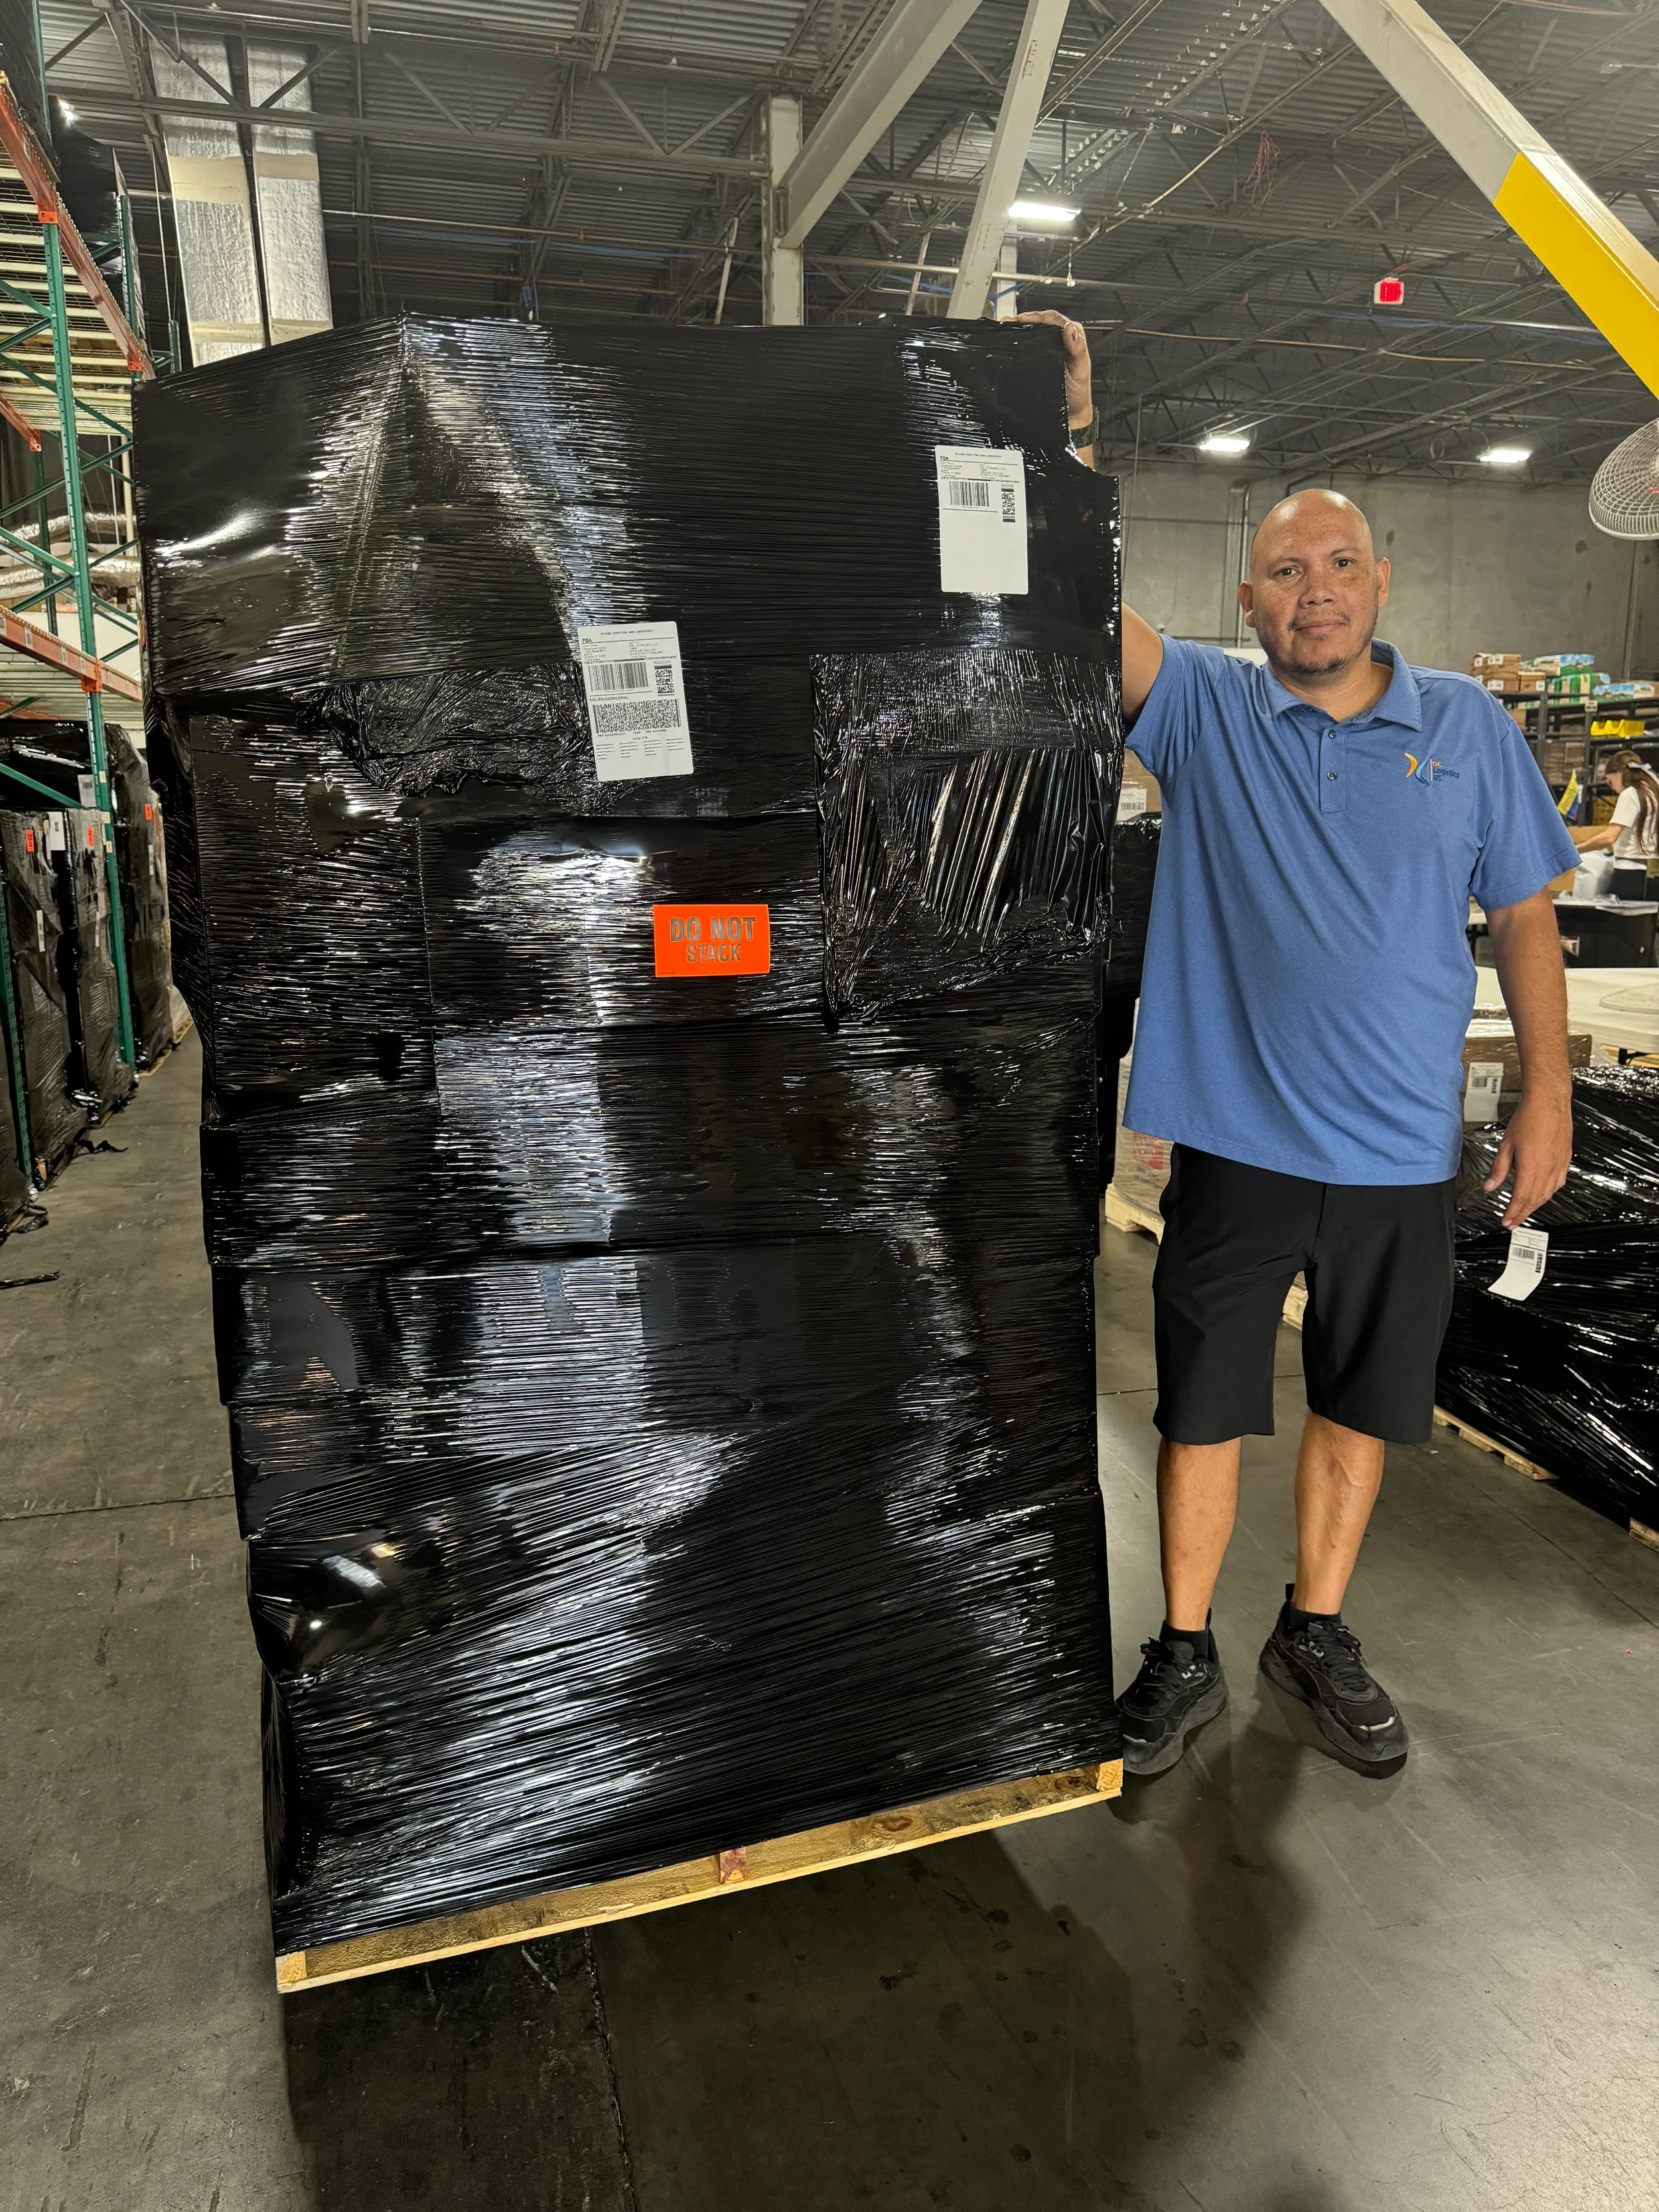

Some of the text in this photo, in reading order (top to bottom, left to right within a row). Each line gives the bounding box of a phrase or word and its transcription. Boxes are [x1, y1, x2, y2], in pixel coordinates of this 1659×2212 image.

[1433, 767, 1460, 778] Logistics
[670, 917, 756, 941] DO NOT
[686, 943, 741, 962] STACK
